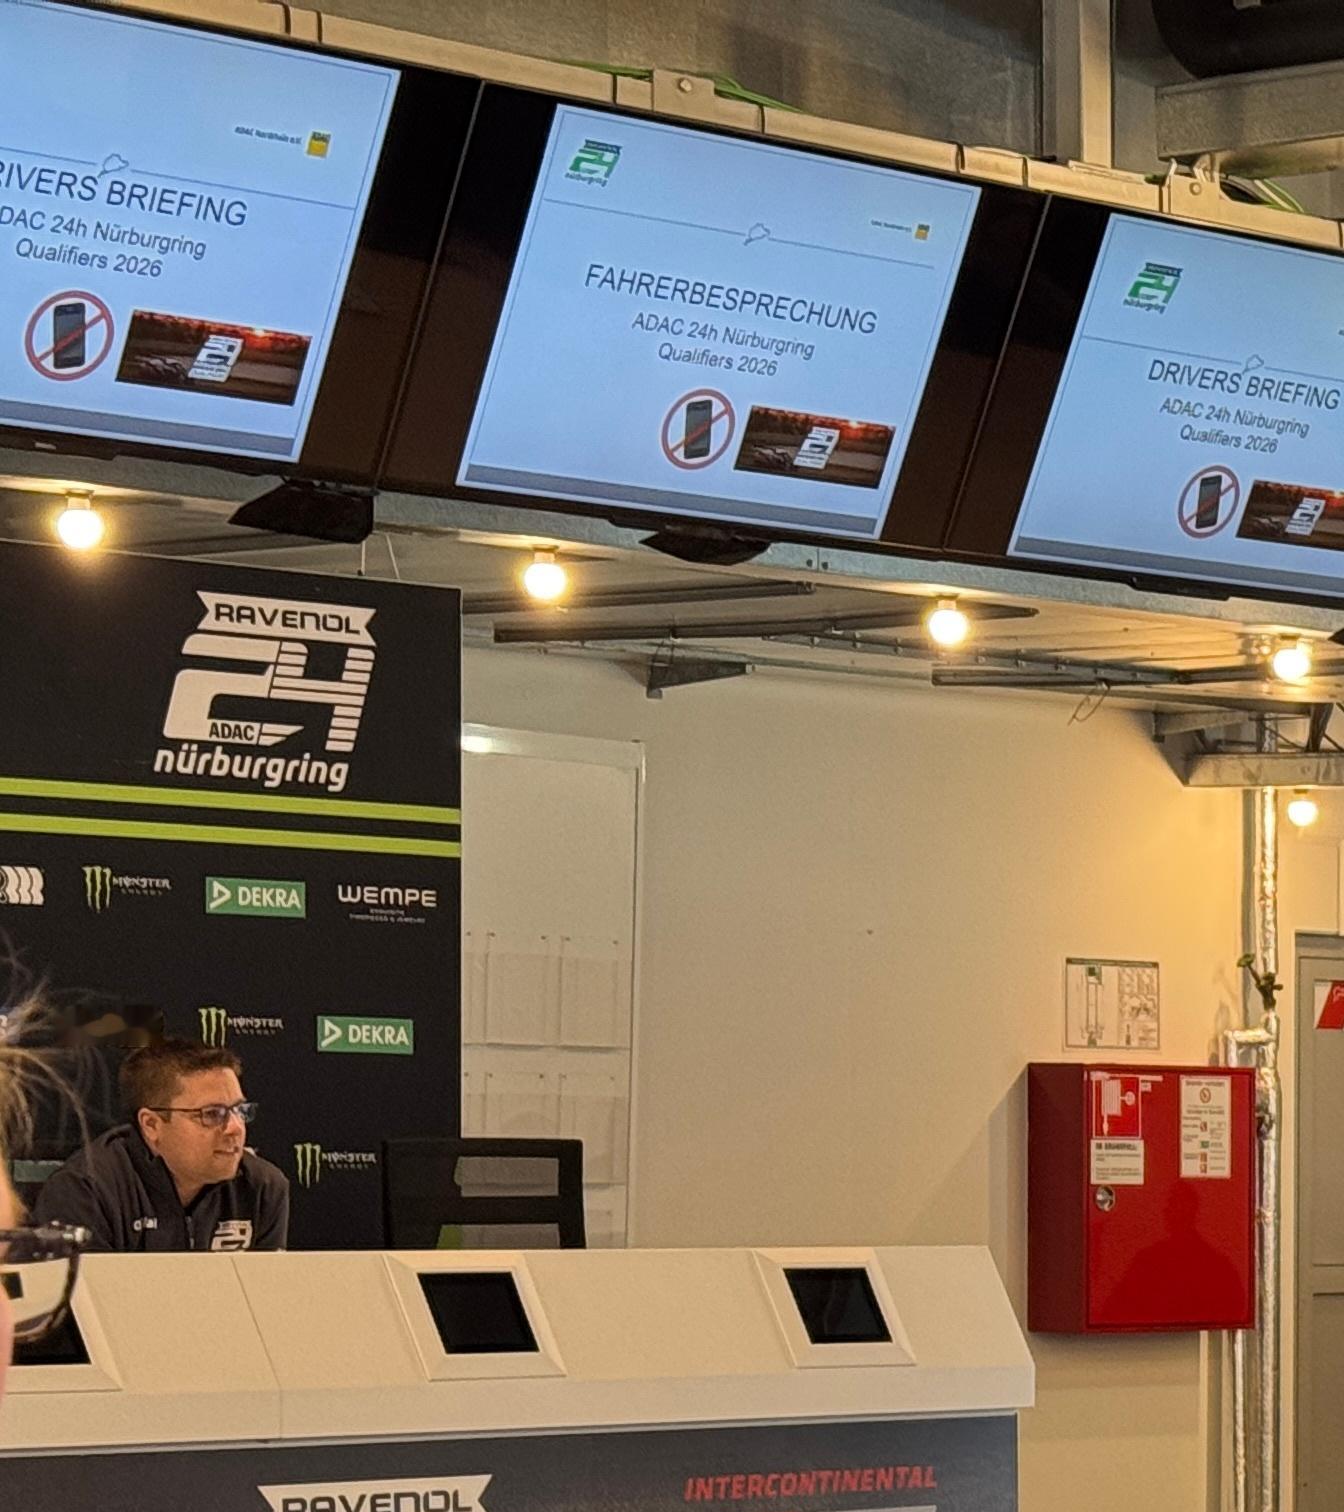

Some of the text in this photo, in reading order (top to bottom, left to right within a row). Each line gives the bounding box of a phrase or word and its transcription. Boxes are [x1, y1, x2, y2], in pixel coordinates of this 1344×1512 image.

[0, 161, 248, 226] IVERS BRIEFING
[16, 238, 163, 278] Qualifiers 2026
[50, 215, 88, 237] 24h
[93, 221, 206, 261] Nürburgring
[584, 264, 878, 334] FAHRERBESPRECHUNG
[631, 312, 815, 360] ADAC 24h Nürburgring
[658, 342, 778, 377] Qualifiers 2026
[1148, 359, 1341, 410] DRIVERS BRIEFING
[1160, 397, 1310, 439] ADAC 24h Nürburgring
[1180, 424, 1279, 454] Qualifiers 2026
[215, 603, 360, 635] RAVENOL
[163, 633, 376, 752] 24
[209, 722, 254, 741] ADAC
[153, 743, 349, 792] nürburgring
[238, 886, 301, 908] DEKRA
[338, 885, 437, 907] WEMPE
[349, 1025, 409, 1045] DEKRA
[684, 1466, 937, 1500] INTERCONTINENTAL
